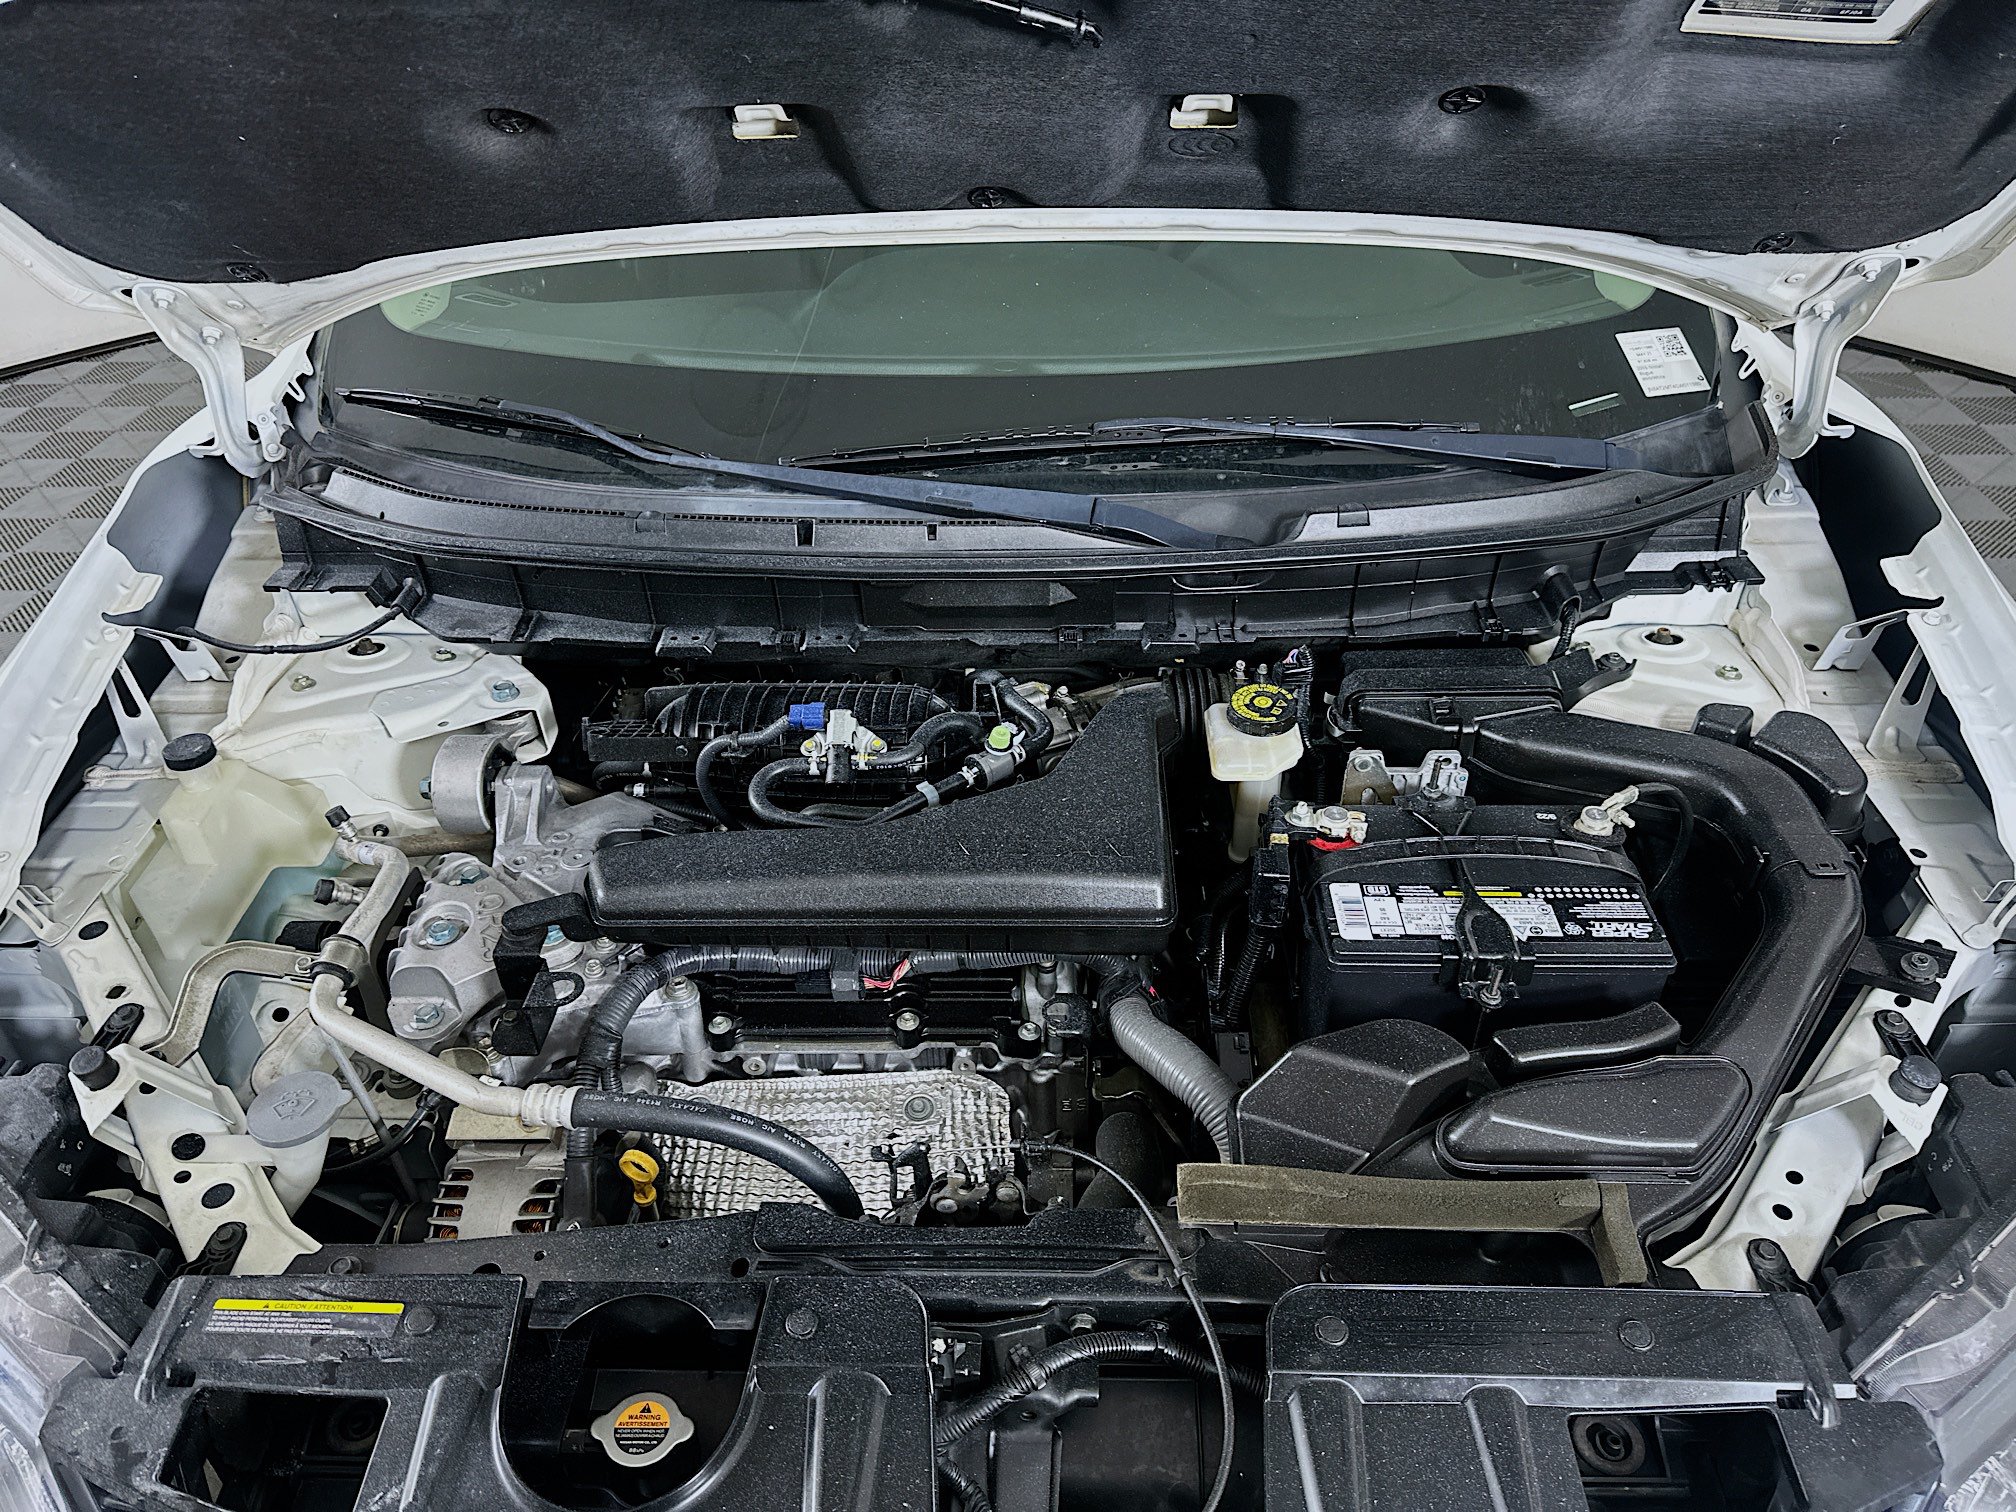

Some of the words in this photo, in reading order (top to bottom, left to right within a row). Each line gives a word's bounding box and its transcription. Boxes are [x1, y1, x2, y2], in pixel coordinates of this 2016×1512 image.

[1589, 921, 1654, 933] START
[1591, 929, 1650, 939] SUPER
[583, 1093, 606, 1101] HOSE
[669, 1102, 707, 1113] GALAXY
[729, 1113, 755, 1125] HOSE
[761, 1123, 777, 1133] A/C
[811, 1149, 839, 1172] GALAXY
[314, 1303, 354, 1311] ATTENTION
